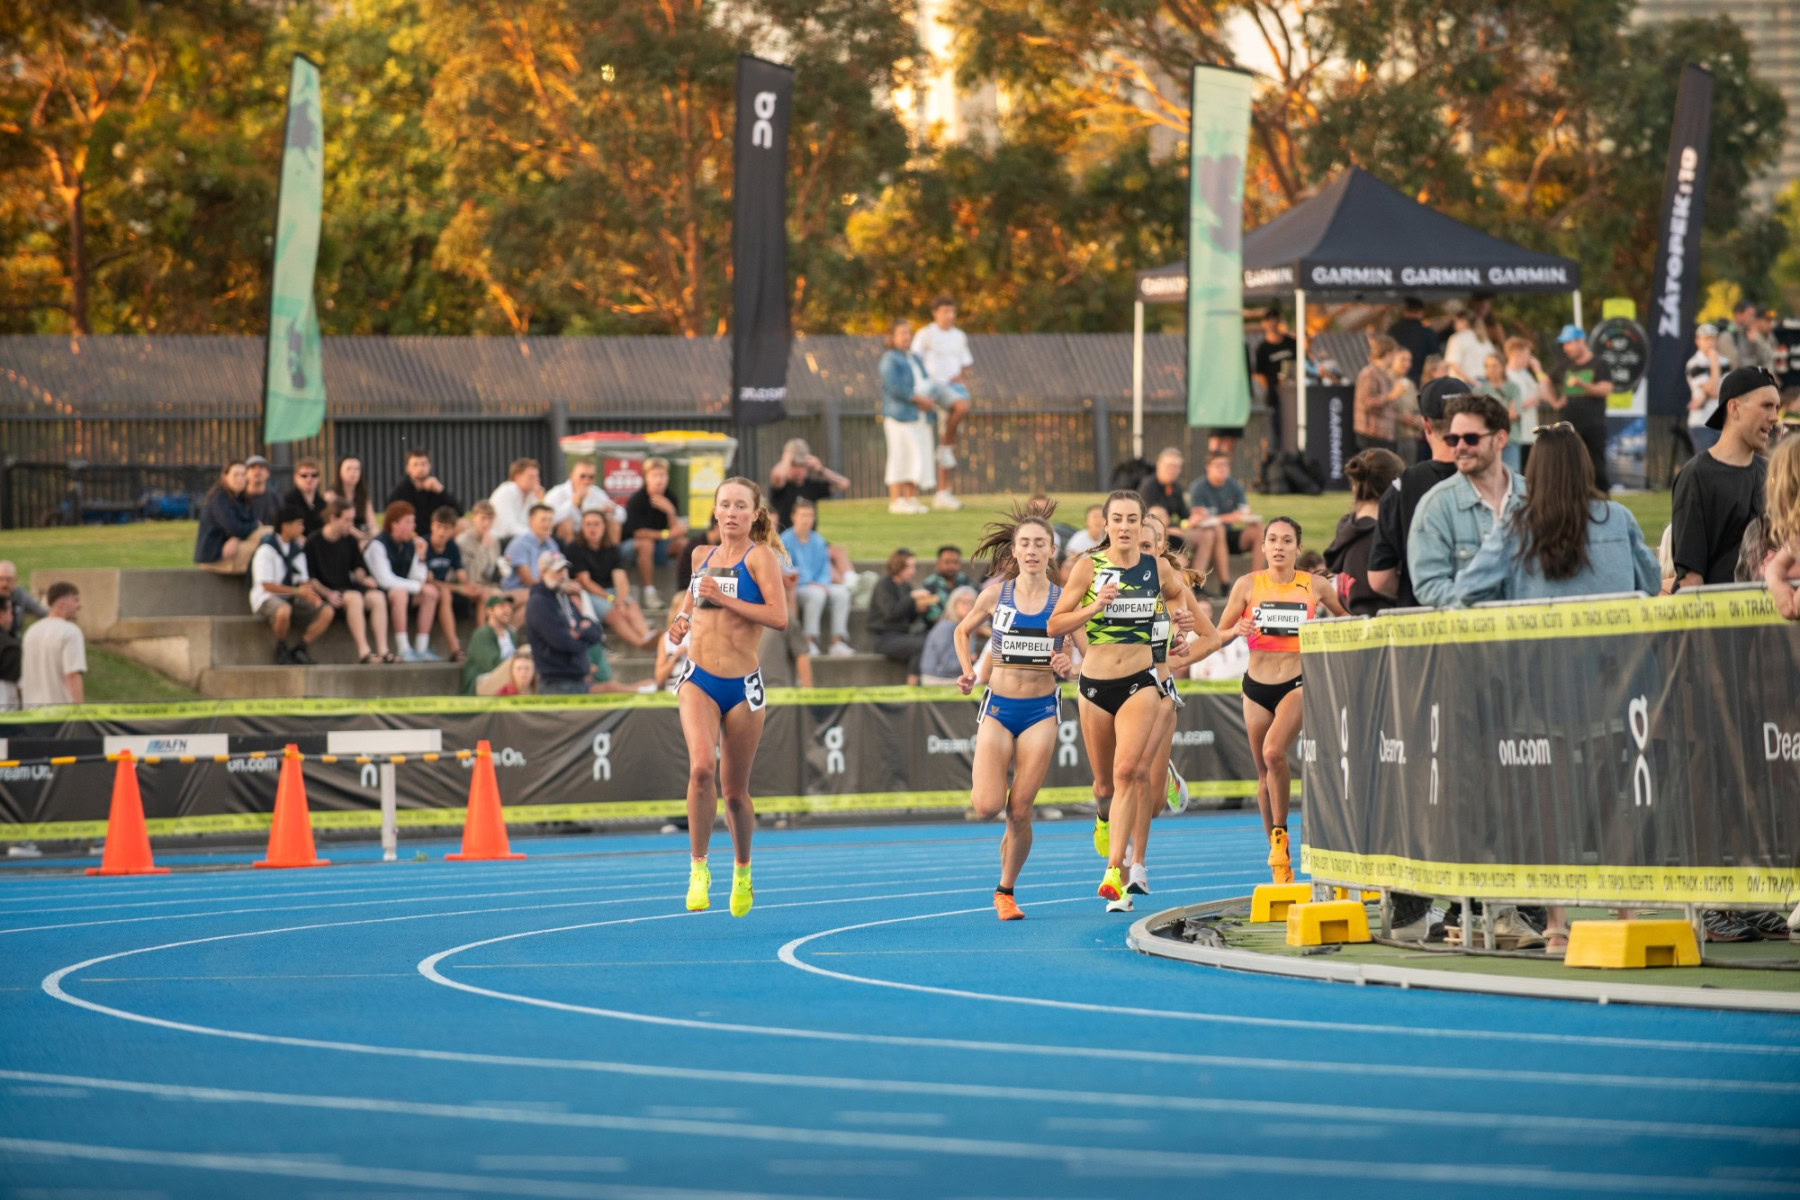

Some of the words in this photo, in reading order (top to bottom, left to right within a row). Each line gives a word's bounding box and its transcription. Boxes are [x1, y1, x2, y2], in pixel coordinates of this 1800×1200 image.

[1311, 266, 1393, 286] GARMIN
[1401, 266, 1481, 286] GARMIN
[1488, 266, 1567, 285] GARMIN
[1100, 572, 1114, 584] 7
[994, 607, 1012, 628] 11
[1106, 603, 1154, 613] POMPEANI
[1266, 614, 1300, 623] WERNER
[1003, 640, 1051, 652] CAMPBELL
[747, 672, 764, 707] 3
[1499, 739, 1551, 767] on.com
